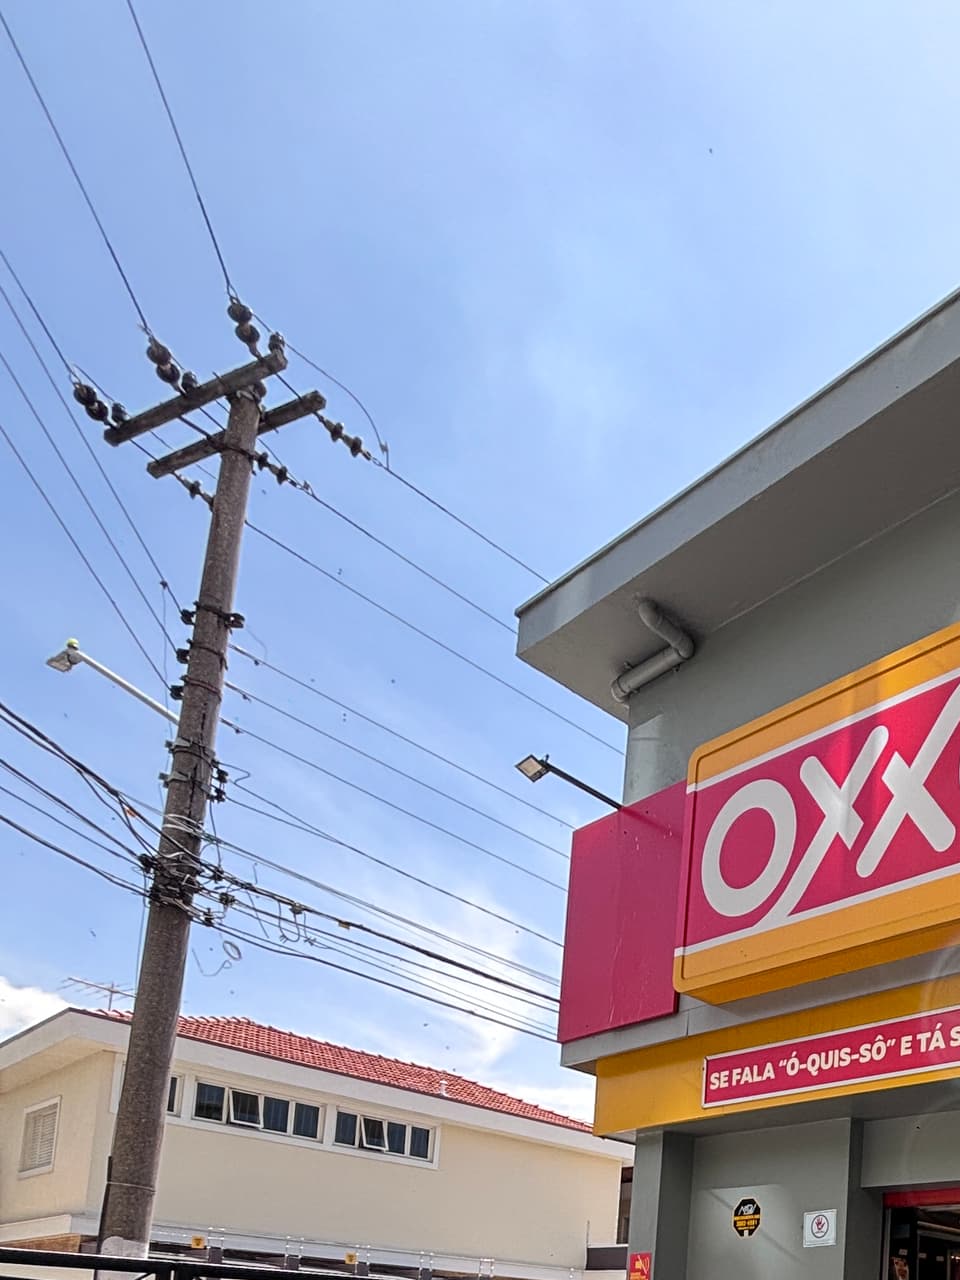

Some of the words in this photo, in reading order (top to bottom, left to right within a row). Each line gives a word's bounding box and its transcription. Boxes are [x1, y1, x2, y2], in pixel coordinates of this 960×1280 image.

[709, 1071, 729, 1091] SE
[732, 1061, 776, 1087] FALA
[900, 1039, 912, 1057] E
[916, 1022, 946, 1053] TÁ
